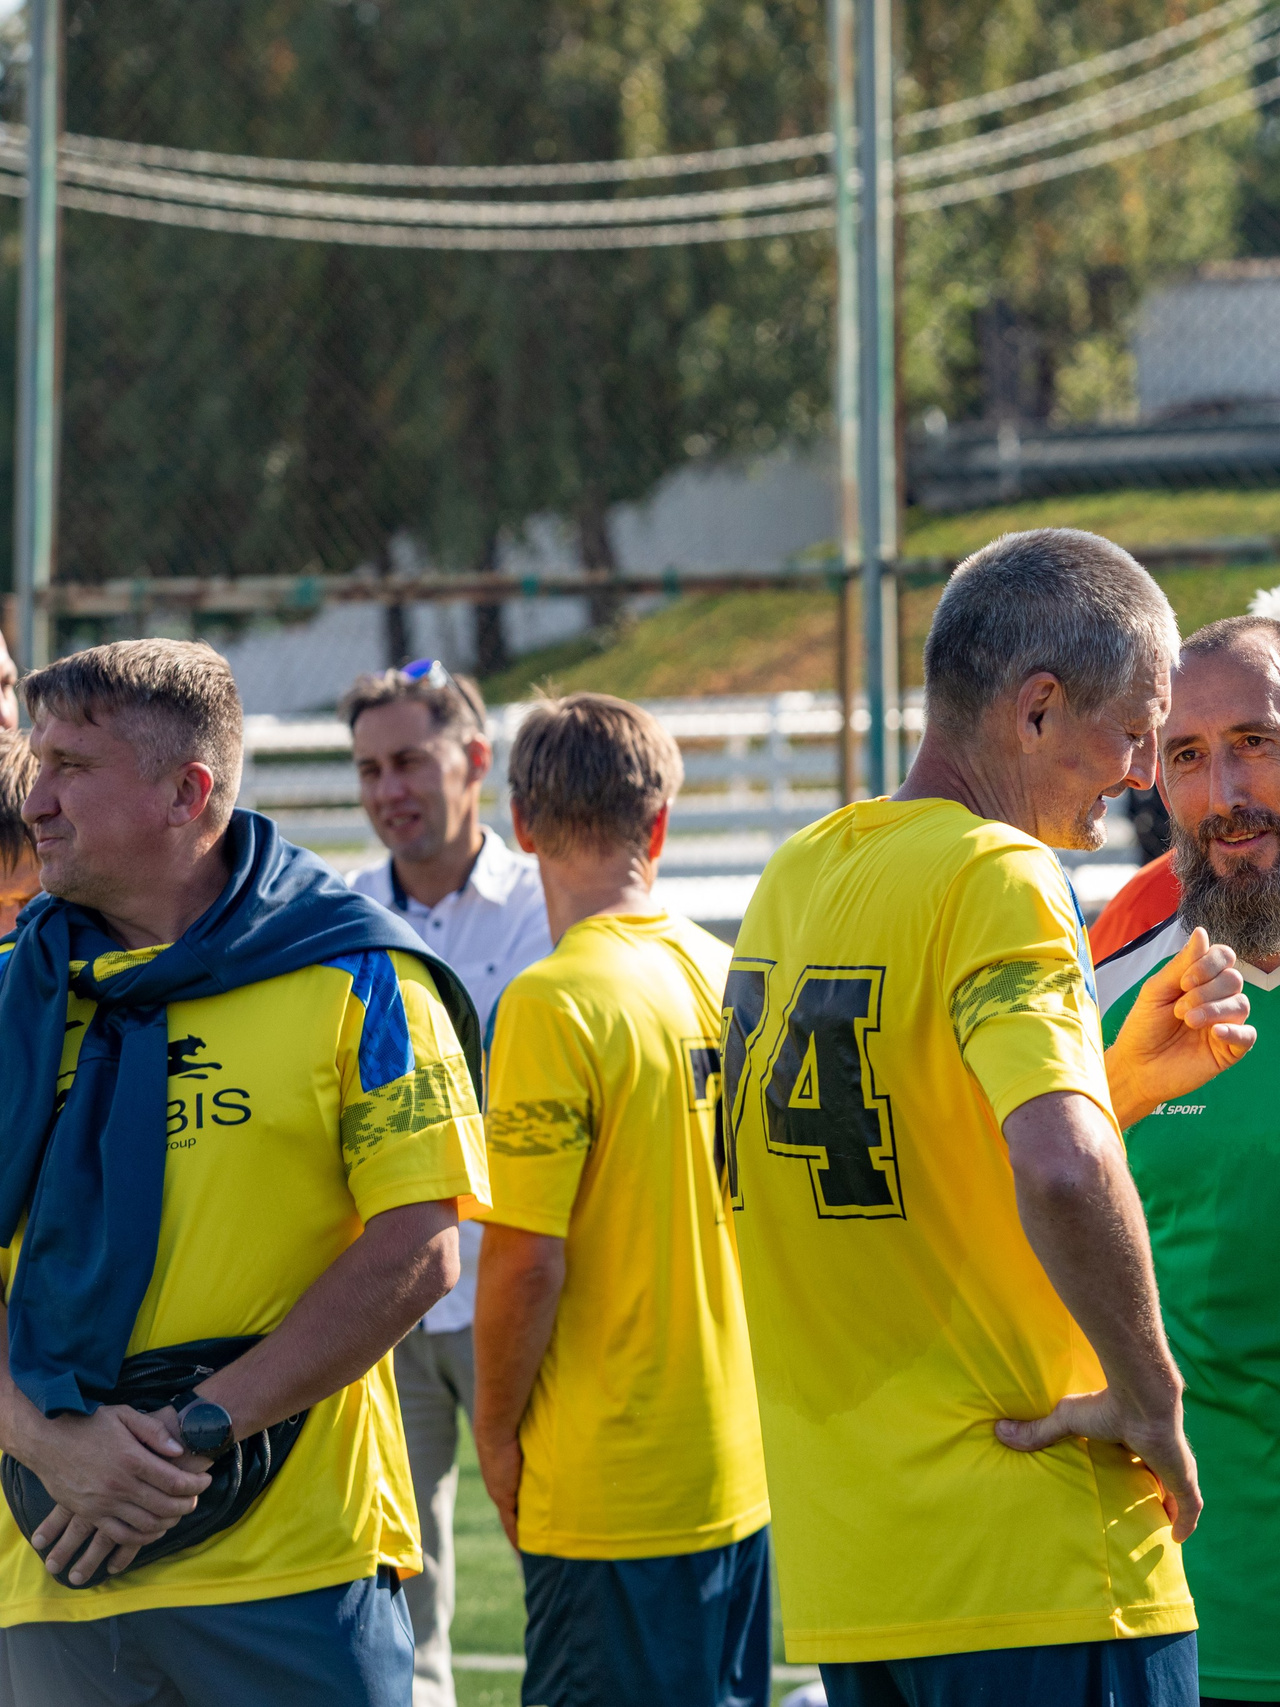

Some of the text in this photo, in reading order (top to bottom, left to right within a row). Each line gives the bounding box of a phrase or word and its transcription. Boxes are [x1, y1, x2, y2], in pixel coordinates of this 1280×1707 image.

[721, 957, 906, 1221] 74
[166, 1087, 252, 1137] BIS
[1166, 1104, 1207, 1115] SPORT
[166, 1137, 197, 1152] roup
